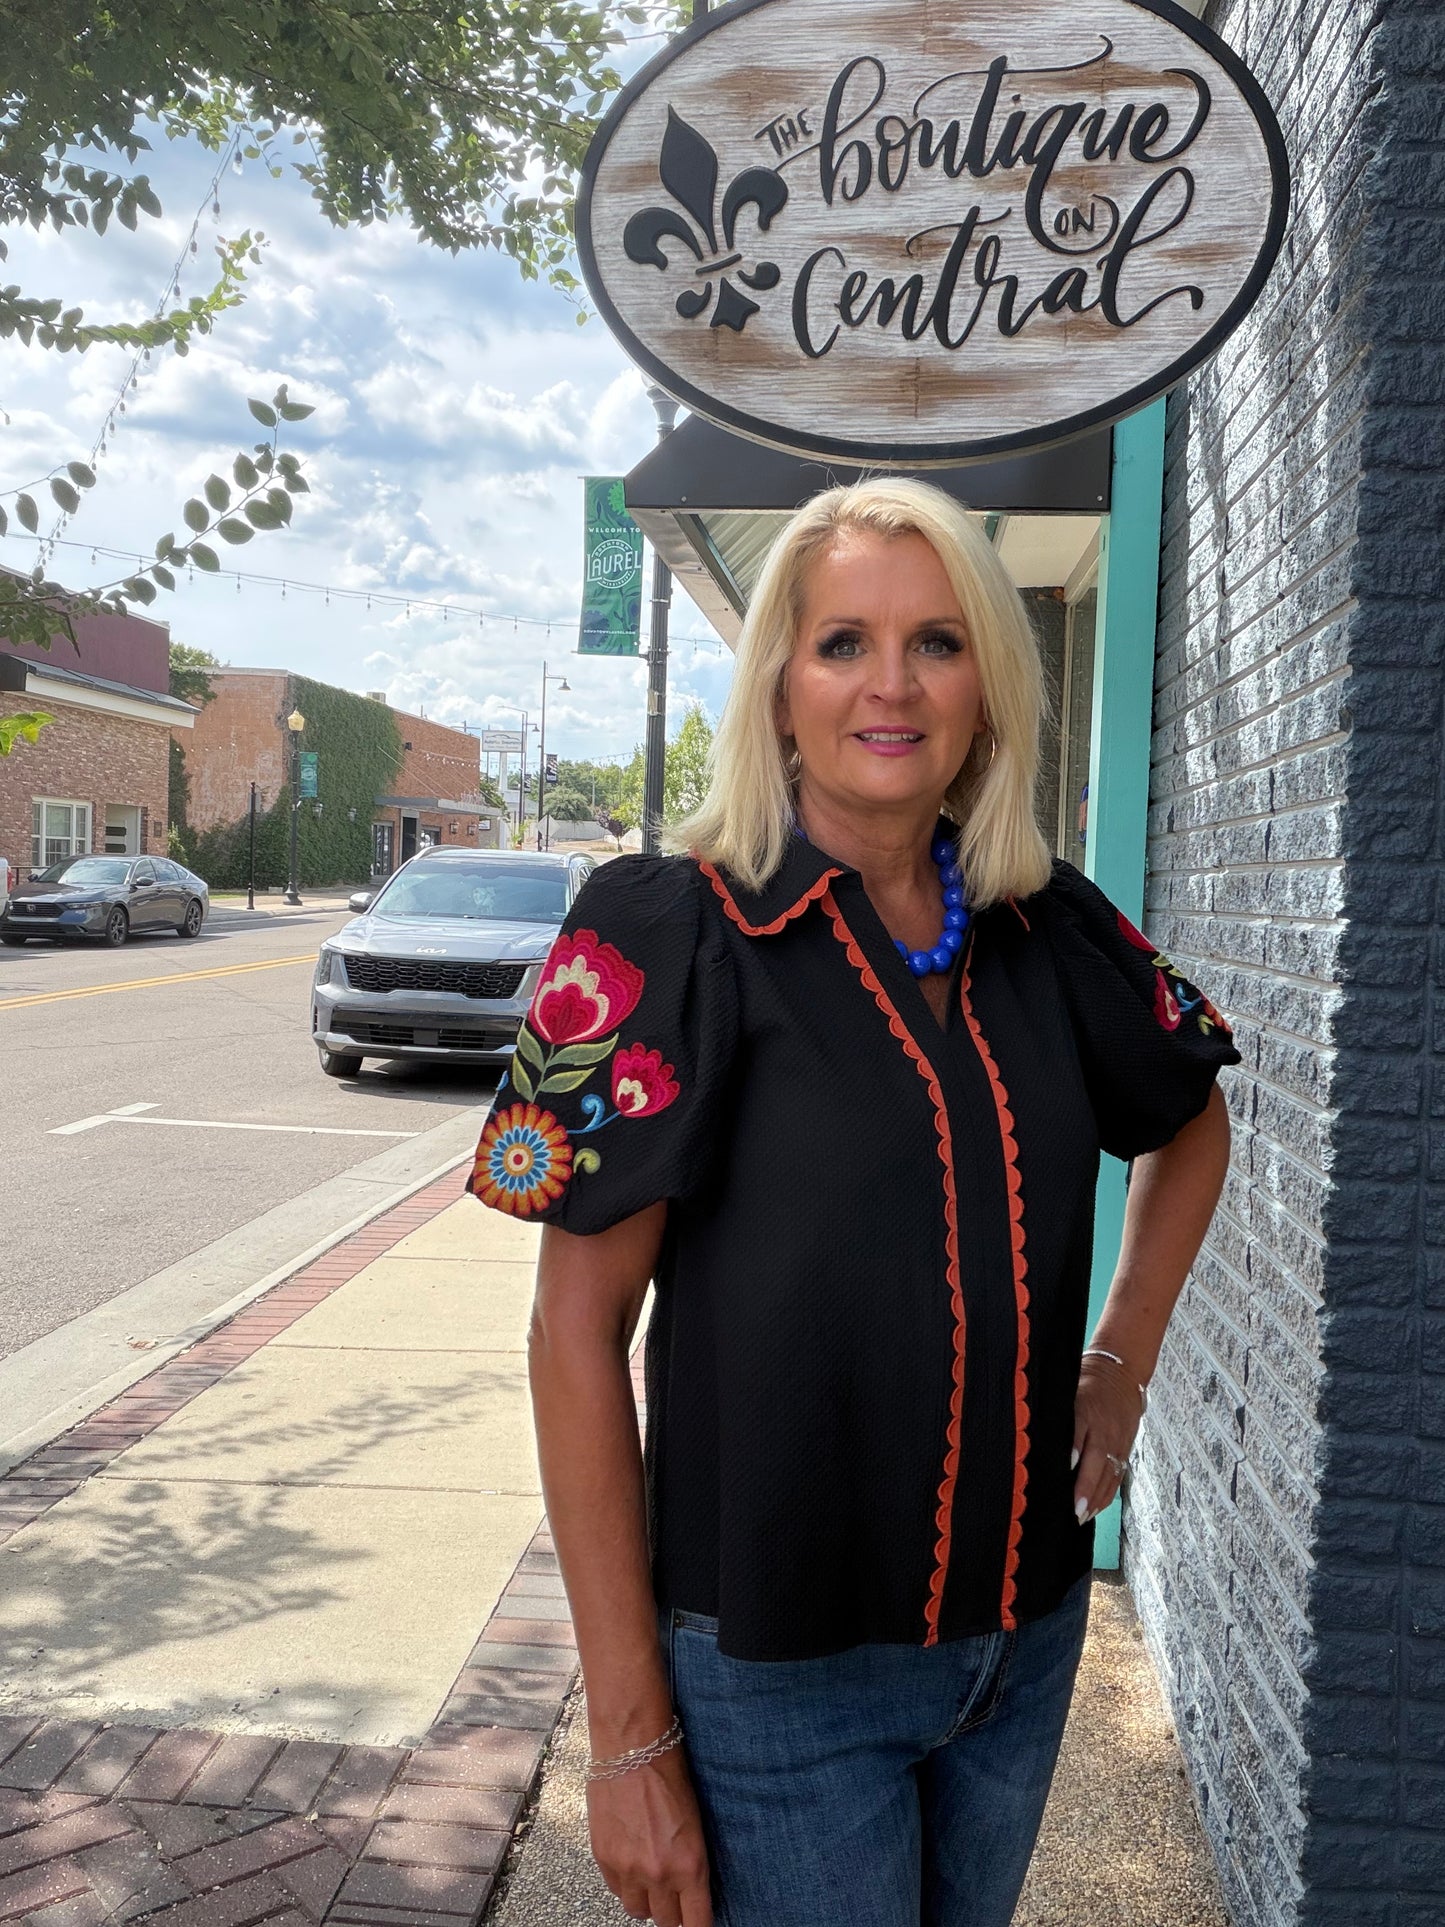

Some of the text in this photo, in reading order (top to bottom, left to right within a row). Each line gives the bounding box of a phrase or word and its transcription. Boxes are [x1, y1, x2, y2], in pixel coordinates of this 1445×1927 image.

[754, 35, 1212, 255] THE boutique
[1053, 202, 1095, 236] ON
[792, 166, 1204, 358] Central
[586, 550, 642, 582] LAUREL
[594, 541, 630, 557] DOWNTOWN
